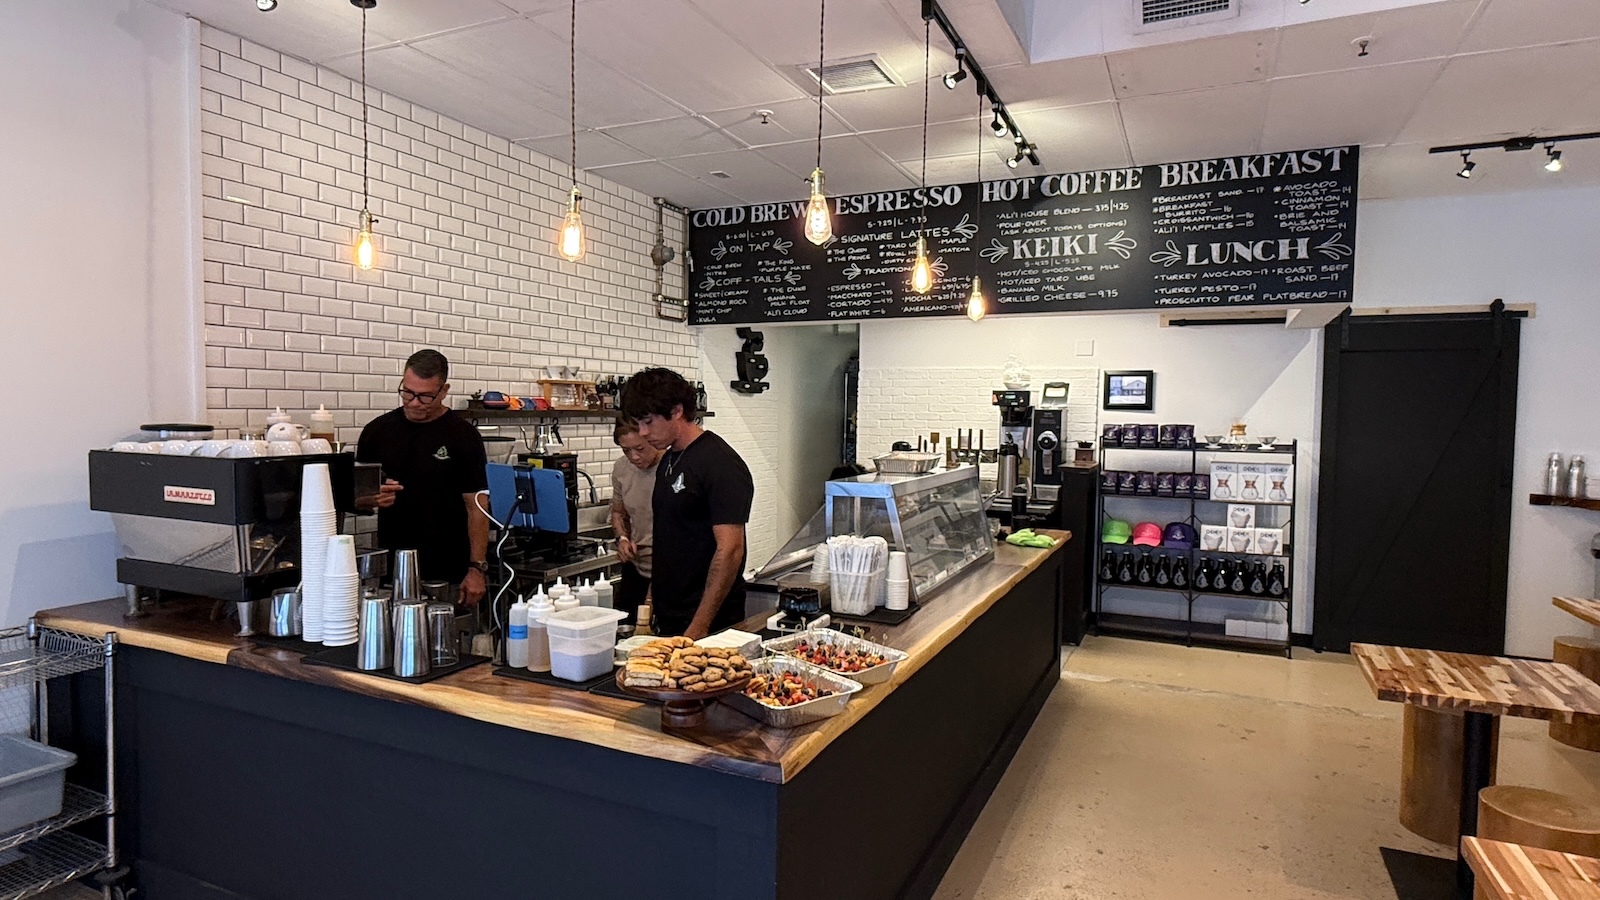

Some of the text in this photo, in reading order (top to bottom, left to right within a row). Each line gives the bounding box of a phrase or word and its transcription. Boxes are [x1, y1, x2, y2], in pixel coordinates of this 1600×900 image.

[1158, 146, 1350, 188] BREAKFAST
[981, 167, 1143, 203] HOT COFFEE
[1283, 180, 1338, 192] AVOCADO
[1158, 191, 1212, 204] BREAKFAST
[1255, 186, 1265, 194] 17
[1288, 185, 1352, 197] TOAST 14
[834, 185, 962, 216] ESPRESSO
[1280, 195, 1341, 206] CINNAMON
[1288, 200, 1350, 211] TOAST 14
[1158, 200, 1213, 213] BREAKFAST
[693, 201, 809, 228] COLD BREW
[1020, 209, 1049, 218] HOUSE
[1053, 207, 1081, 216] BLEND
[1164, 208, 1207, 218] BURRITO
[1279, 209, 1340, 221] BRIE AND
[999, 218, 1048, 230] POUR-OVER
[1157, 213, 1234, 226] CROISSANTWICH
[1279, 217, 1338, 228] BALSAMIC
[1022, 226, 1051, 234] ABOUT
[1182, 221, 1234, 232] MAFFLES
[1288, 222, 1347, 233] TOAST 14
[840, 226, 950, 244] SIGNATURE LATTES
[941, 237, 968, 245] MAPLE
[1012, 233, 1098, 260] KEIKI
[729, 241, 770, 254] ON TAP
[940, 246, 971, 254] MATCHA
[1186, 237, 1310, 267] LUNCH
[886, 250, 907, 258] ROYAL
[761, 265, 789, 273] PURPLE
[1000, 263, 1120, 278] HOT/ICED CHOCOLATE MILK
[1159, 267, 1269, 281] TURKEY AVOCADO 17
[1276, 263, 1350, 275] ROAST BEEF
[716, 276, 742, 287] COFF
[752, 274, 782, 284] TAILS
[905, 276, 958, 285] CCCINO
[1000, 273, 1096, 286] HOT/ICED TARO UBE
[1284, 272, 1339, 284] SAND 17
[771, 285, 807, 294] THE DUKE
[830, 282, 873, 292] ESPRESSO
[1000, 284, 1066, 294] BANANA MILK
[1158, 282, 1258, 295] TURKEY PESTO 17
[767, 294, 797, 302] BANANA
[830, 291, 873, 300] MACCHIATO
[904, 294, 932, 303] MOCHA
[1000, 295, 1040, 304] GRILLED
[1043, 291, 1087, 302] CHEESE
[1159, 289, 1348, 306] PROSCIUTTO PEAR FLATBREAD 17
[698, 299, 728, 307] ALMOND
[830, 299, 872, 308] CORTADO
[903, 304, 948, 313] AMERICANO
[782, 308, 808, 316] CLOUD
[830, 310, 848, 318] FLAT
